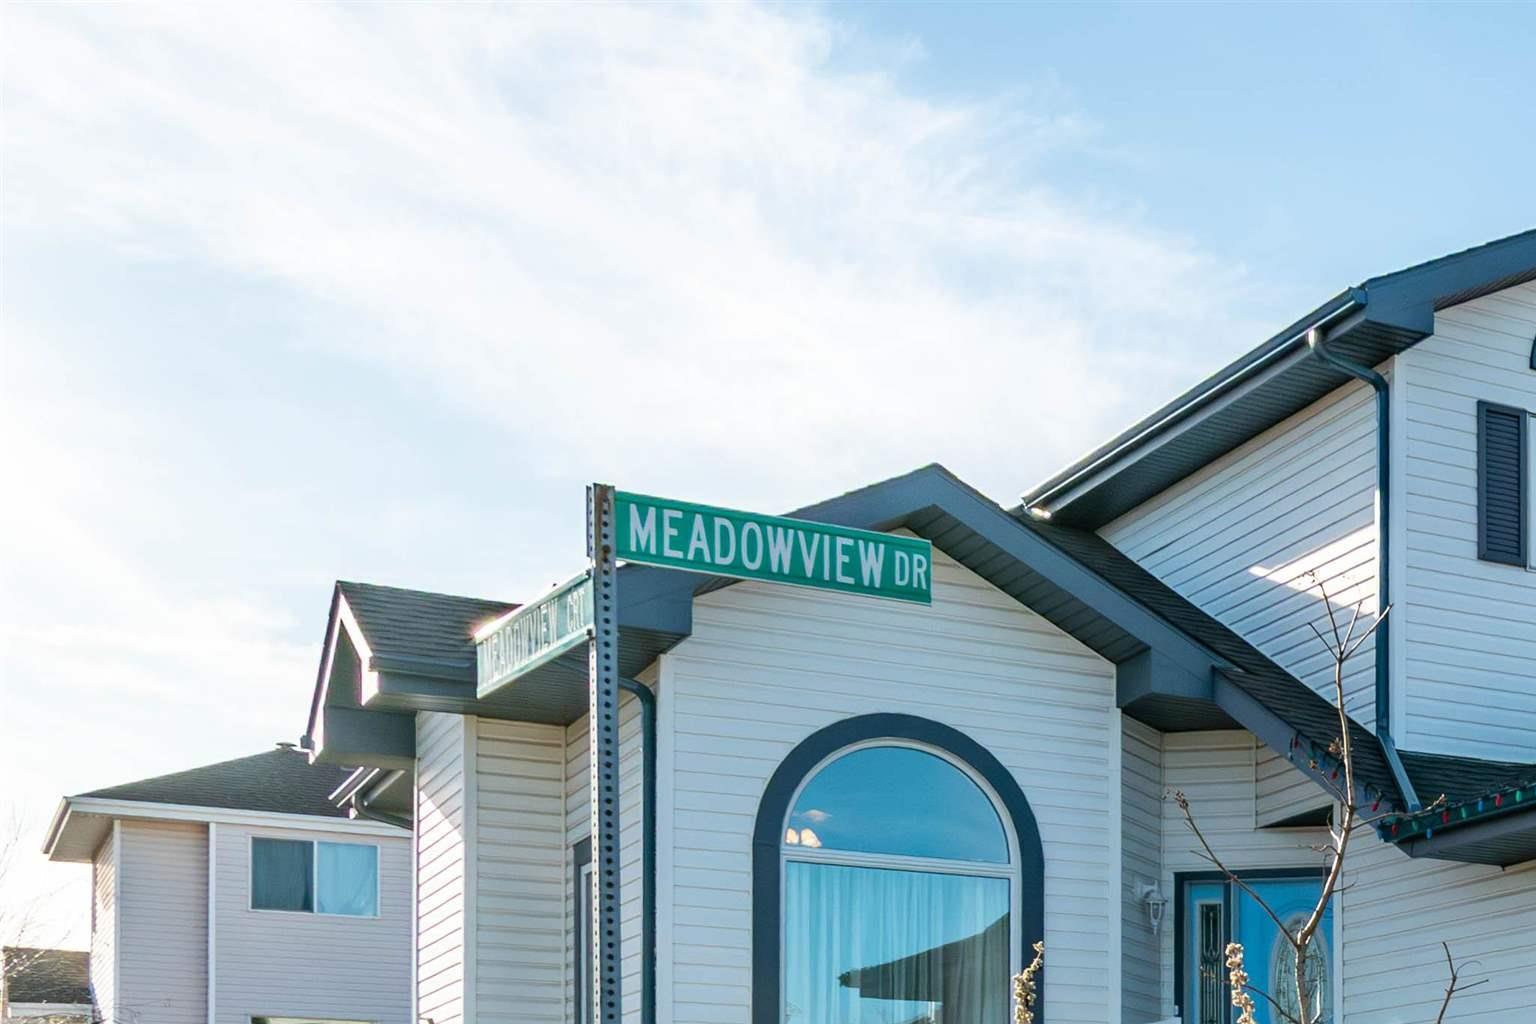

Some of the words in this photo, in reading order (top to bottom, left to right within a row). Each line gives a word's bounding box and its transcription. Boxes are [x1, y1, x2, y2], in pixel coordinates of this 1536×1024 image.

[629, 505, 886, 588] MEADOWVIEW
[894, 550, 928, 590] DR
[482, 597, 558, 687] MEADOWVIEW
[567, 587, 585, 633] CRT
